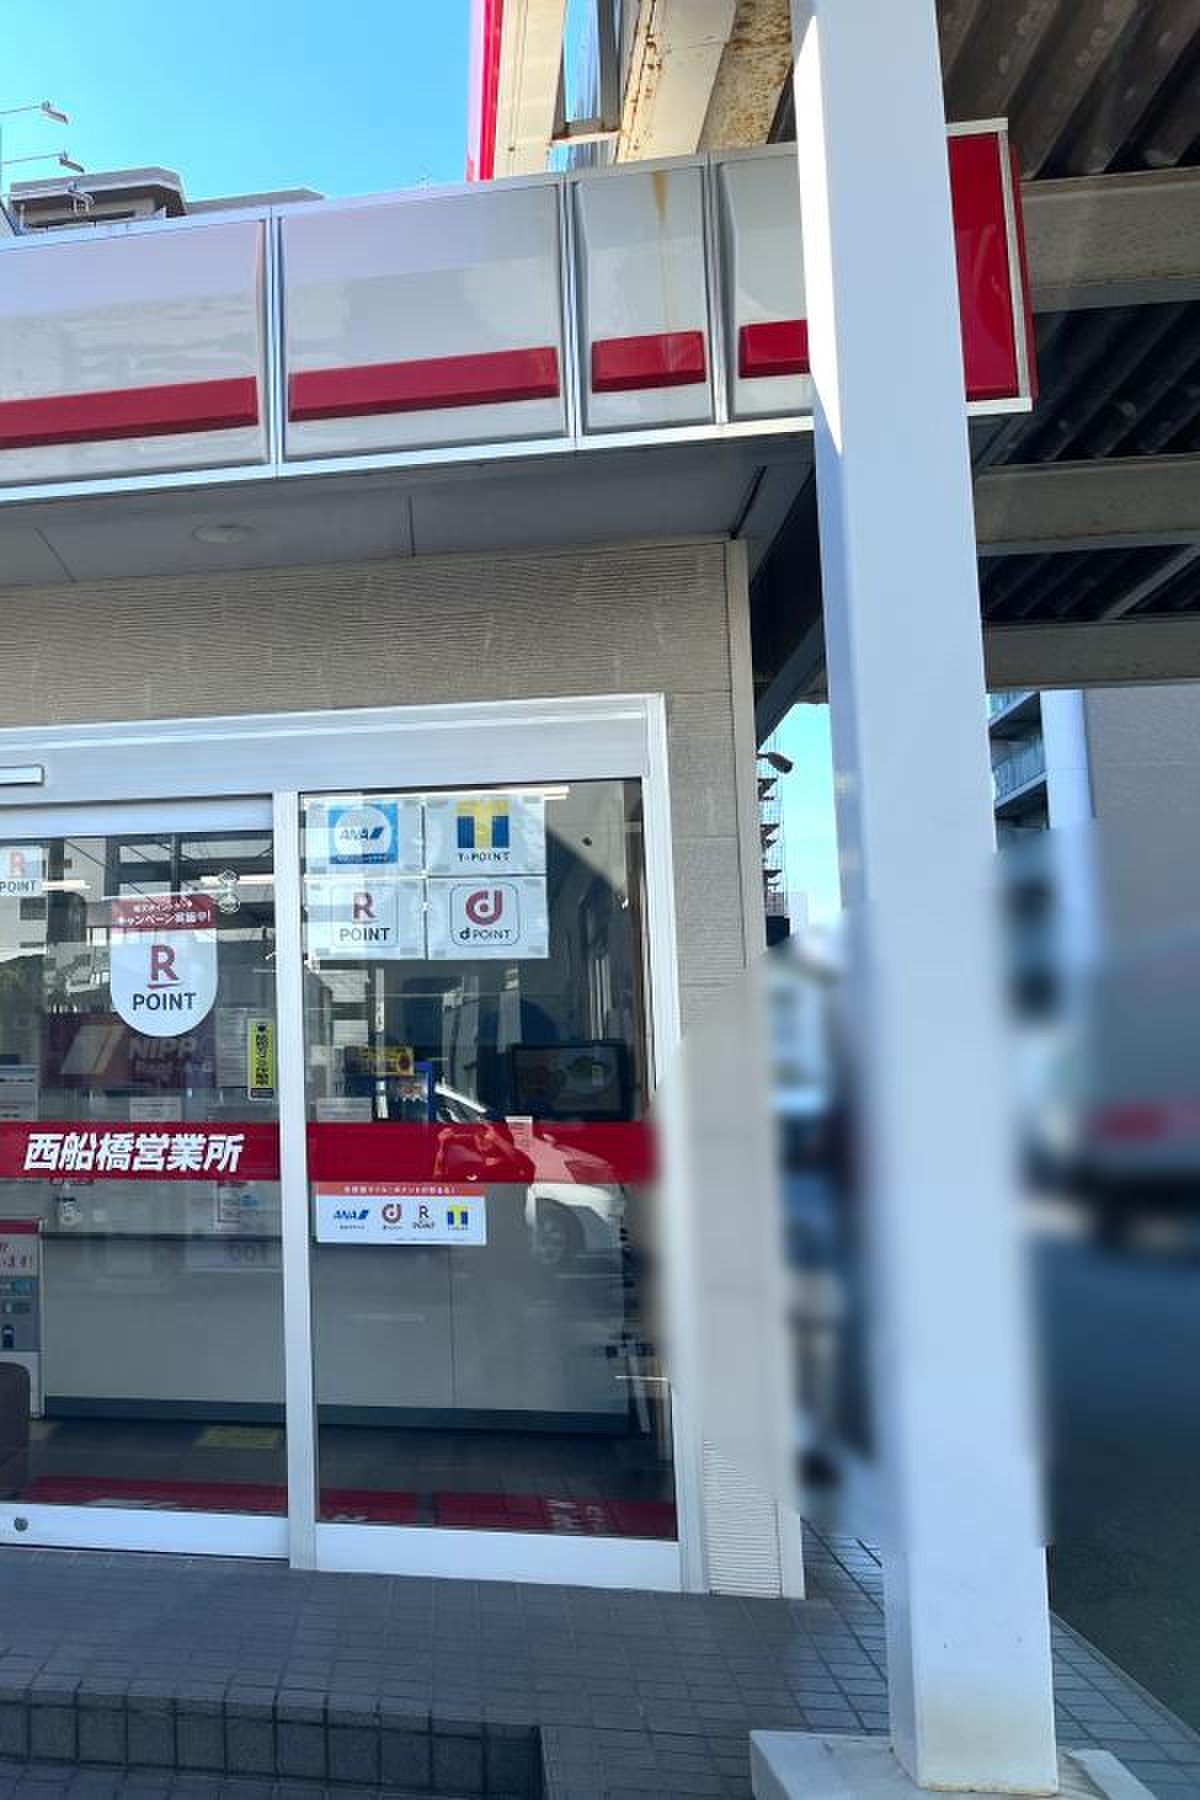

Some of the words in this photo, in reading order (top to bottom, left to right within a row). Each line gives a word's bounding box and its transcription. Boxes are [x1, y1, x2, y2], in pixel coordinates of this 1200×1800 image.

[0, 879, 37, 893] POINT
[352, 891, 376, 920] R
[339, 927, 391, 942] POINT
[150, 944, 180, 982] R
[132, 992, 197, 1011] POINT
[23, 1132, 245, 1172] 西船橋営業所
[333, 1209, 357, 1221] ANA
